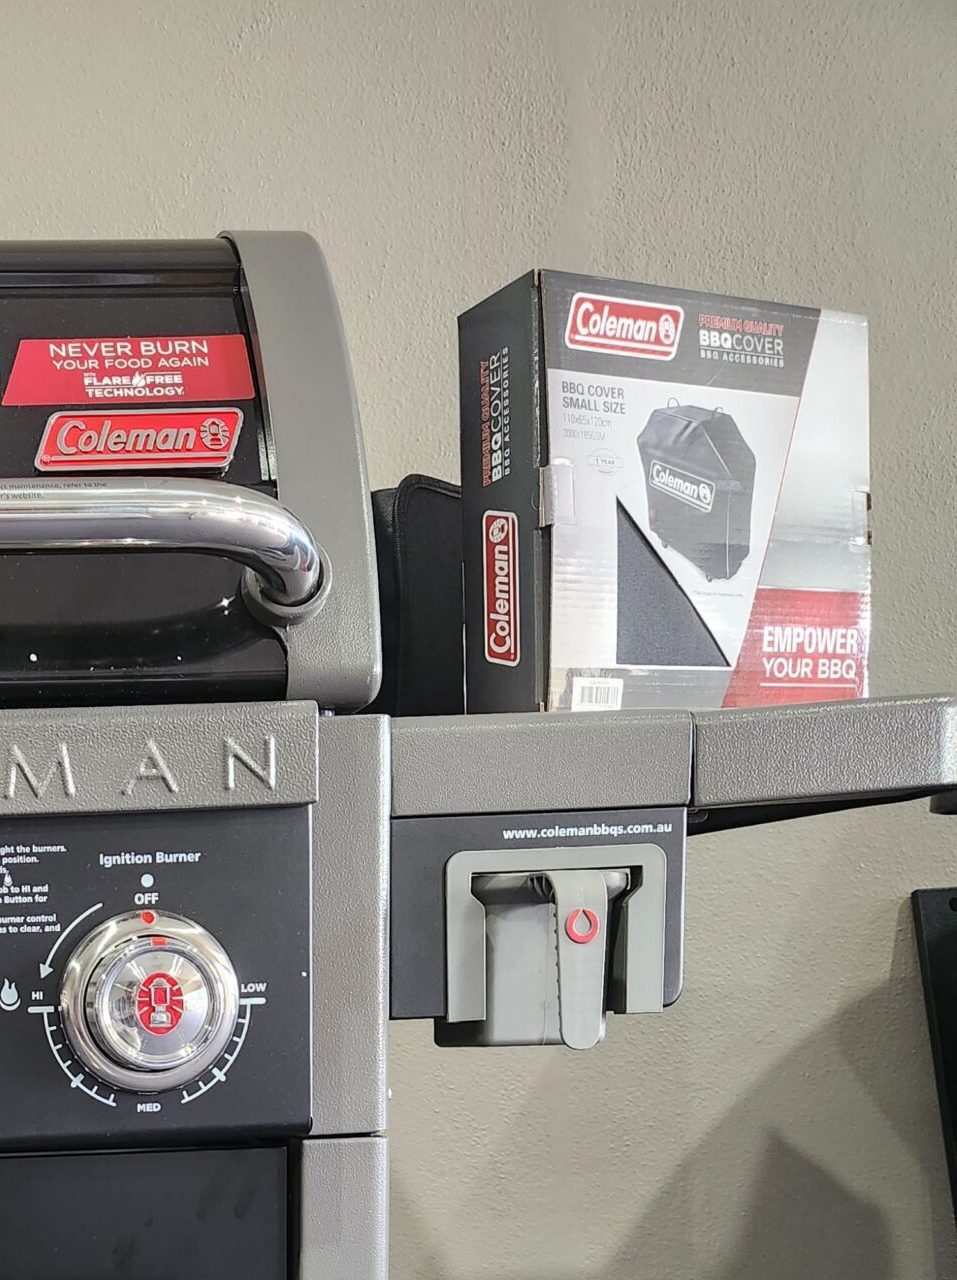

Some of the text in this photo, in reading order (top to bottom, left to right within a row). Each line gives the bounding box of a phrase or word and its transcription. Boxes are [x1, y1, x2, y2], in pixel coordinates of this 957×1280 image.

[576, 301, 656, 343] Coleman
[699, 313, 784, 337] PREMIUM QUALITY
[49, 340, 209, 358] NEVER BURN
[52, 356, 209, 371] YOUR FOOD AGAIN
[700, 349, 784, 367] BBQ ACCESSORIES
[84, 374, 183, 386] FLARE FREE
[86, 386, 184, 398] TECHNOLOGY
[562, 381, 625, 400] BBQ COVER
[562, 396, 627, 415] SMALL SIZE
[56, 419, 196, 455] Coleman
[653, 463, 698, 498] Coleman
[12, 492, 44, 500] website.
[489, 545, 511, 653] Coleman
[762, 625, 858, 655] EMPOWER
[763, 657, 857, 680] YOUR BBQ
[502, 822, 673, 840] www.colemanbbqs.com.au
[16, 844, 31, 853] the
[32, 843, 67, 852] burners.
[2, 854, 39, 865] position.
[99, 851, 201, 867] Ignition Burner
[10, 885, 20, 893] to
[21, 884, 30, 892] HI
[32, 883, 49, 892] and
[4, 895, 33, 903] Button
[34, 894, 48, 902] for
[134, 892, 159, 905] OFF
[26, 913, 56, 922] control
[8, 925, 18, 933] to
[20, 924, 42, 933] clear,
[44, 923, 60, 932] and
[241, 982, 267, 993] LOW
[32, 991, 43, 1001] HI
[137, 1103, 161, 1113] MED
